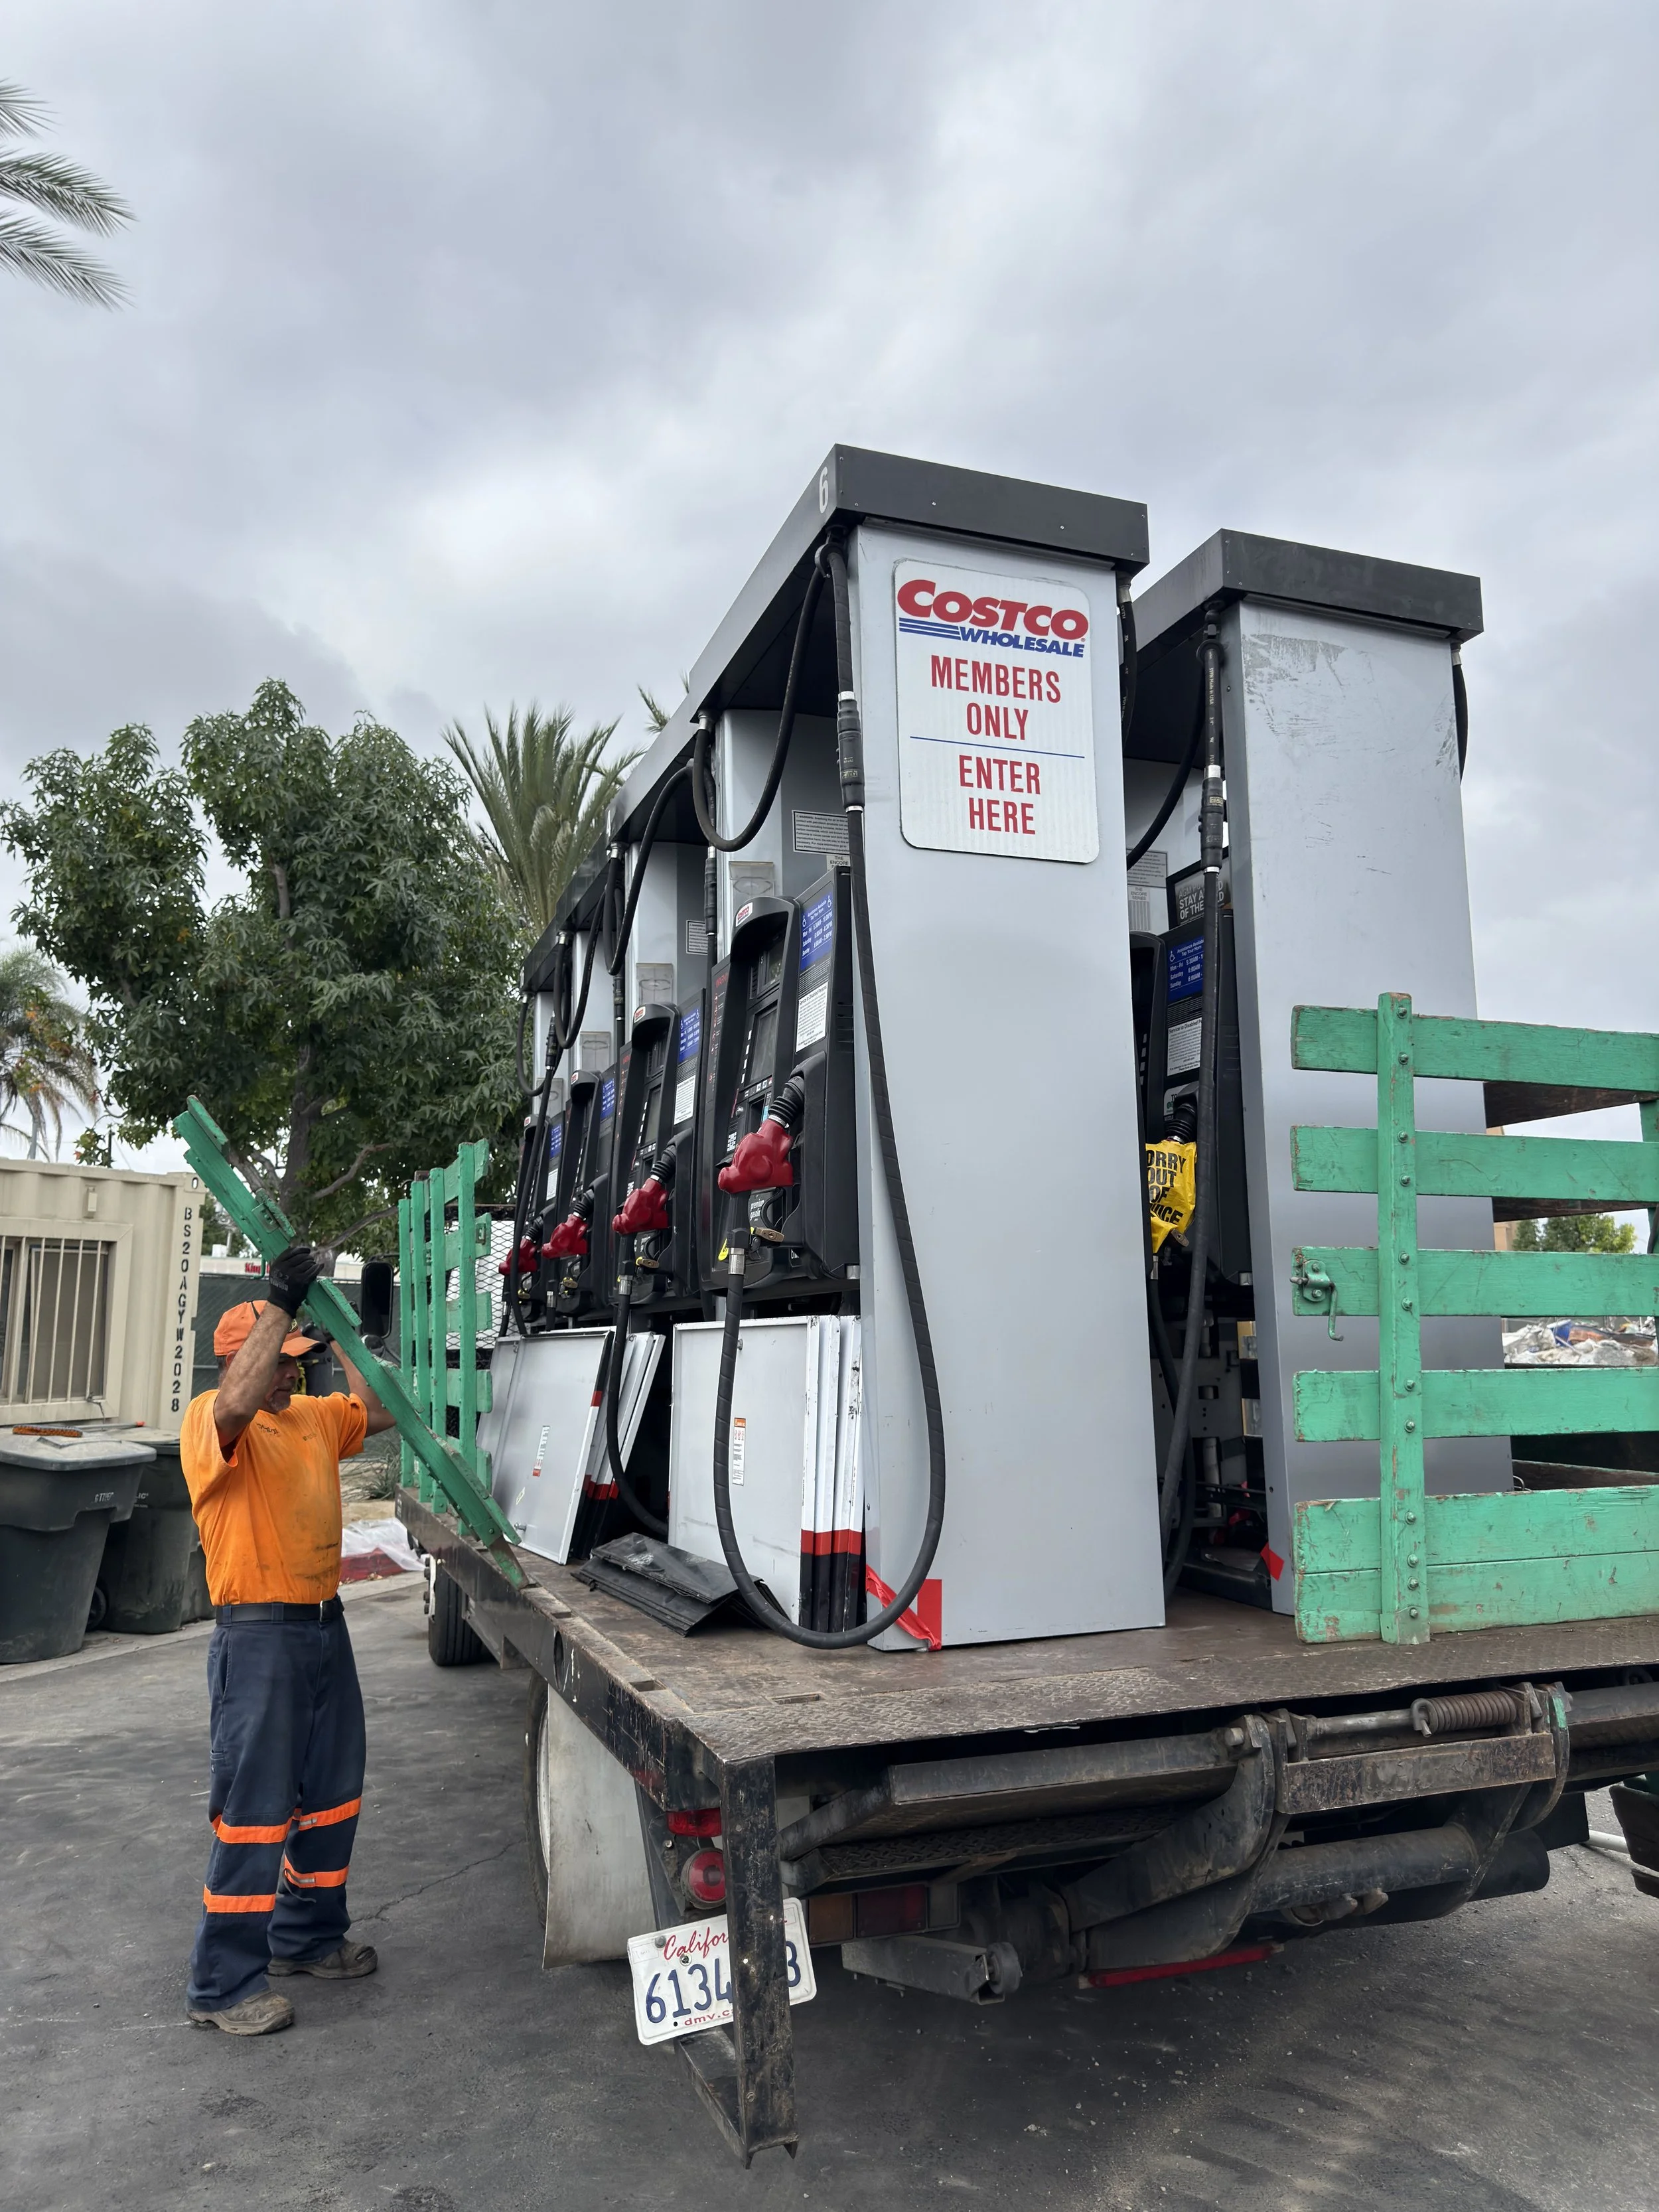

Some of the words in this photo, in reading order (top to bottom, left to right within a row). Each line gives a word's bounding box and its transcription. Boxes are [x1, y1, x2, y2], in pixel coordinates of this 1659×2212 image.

[819, 467, 829, 514] 6
[897, 579, 1088, 640] COSTCO
[960, 626, 1084, 658] WHOLESALE
[931, 655, 1060, 703] MEMBERS
[967, 702, 1029, 741] ONLY
[959, 755, 1041, 794] ENTER
[969, 797, 1035, 835] HERE
[1179, 893, 1198, 909] STAY
[1180, 909, 1189, 920] OF
[1190, 900, 1204, 915] THE
[1185, 1021, 1198, 1029] Disabled
[1147, 1149, 1187, 1174] ORRY
[1147, 1167, 1177, 1188] OUT
[1149, 1185, 1170, 1203] OF
[664, 1927, 729, 1960] Califor
[646, 1941, 801, 2024] 61343
